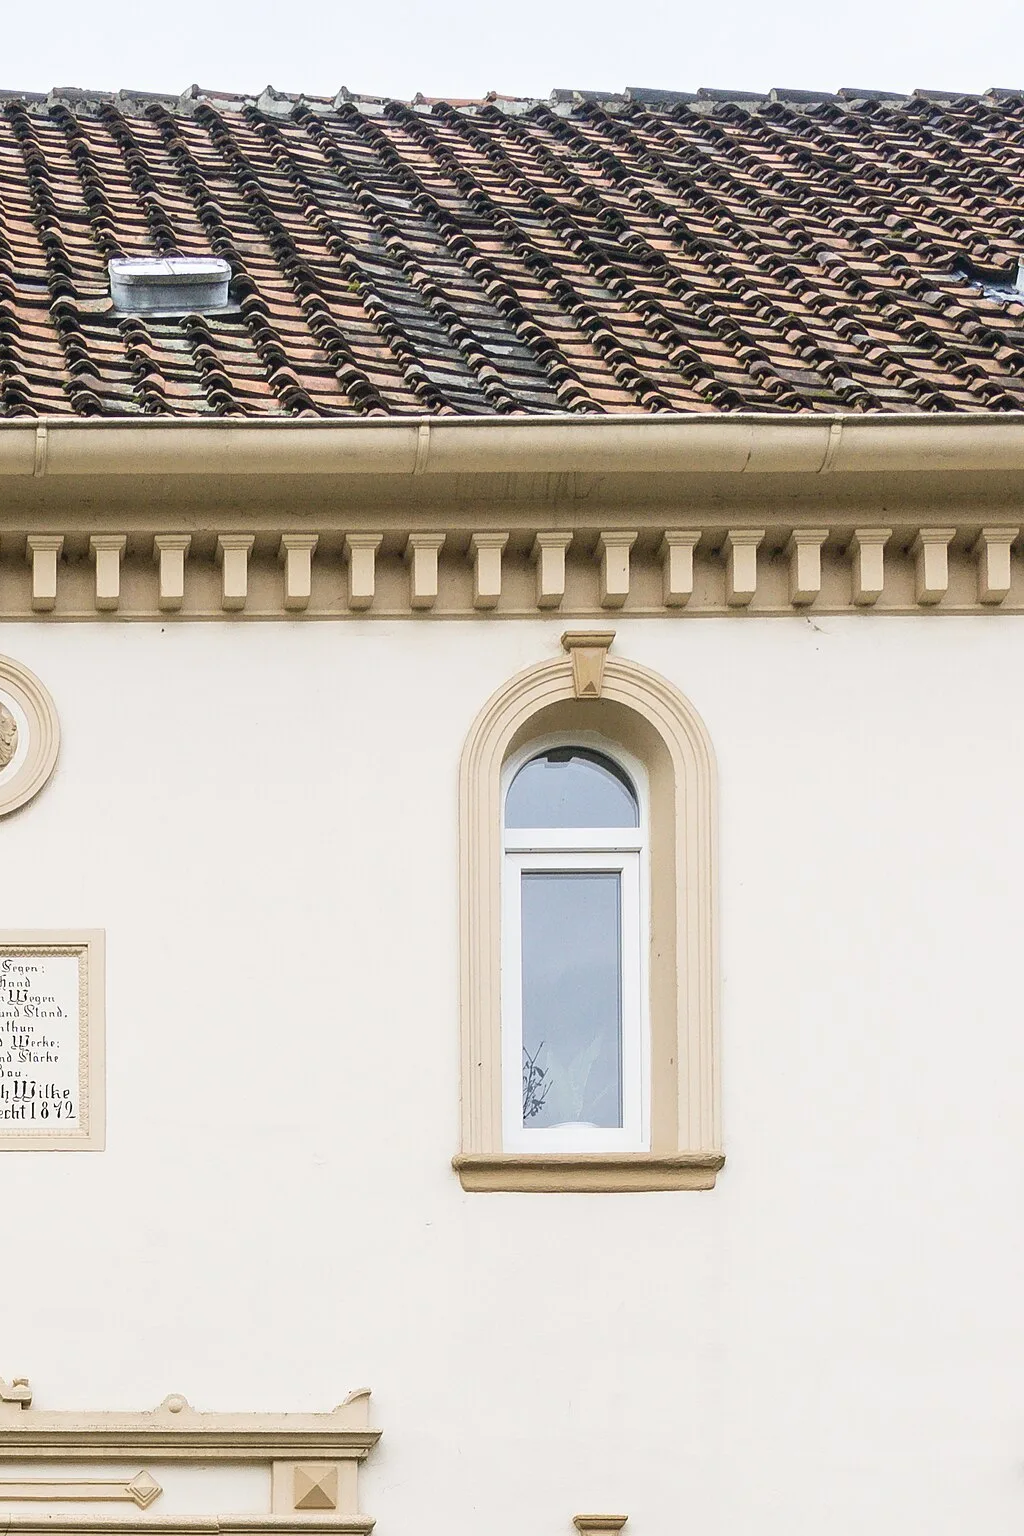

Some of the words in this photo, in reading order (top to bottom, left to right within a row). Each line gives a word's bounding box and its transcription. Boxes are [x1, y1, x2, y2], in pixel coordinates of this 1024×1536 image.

[7, 990, 55, 1005] Wegen
[18, 1050, 59, 1063] Stärke
[13, 1080, 70, 1102] Wilke
[30, 1101, 76, 1120] 1872
